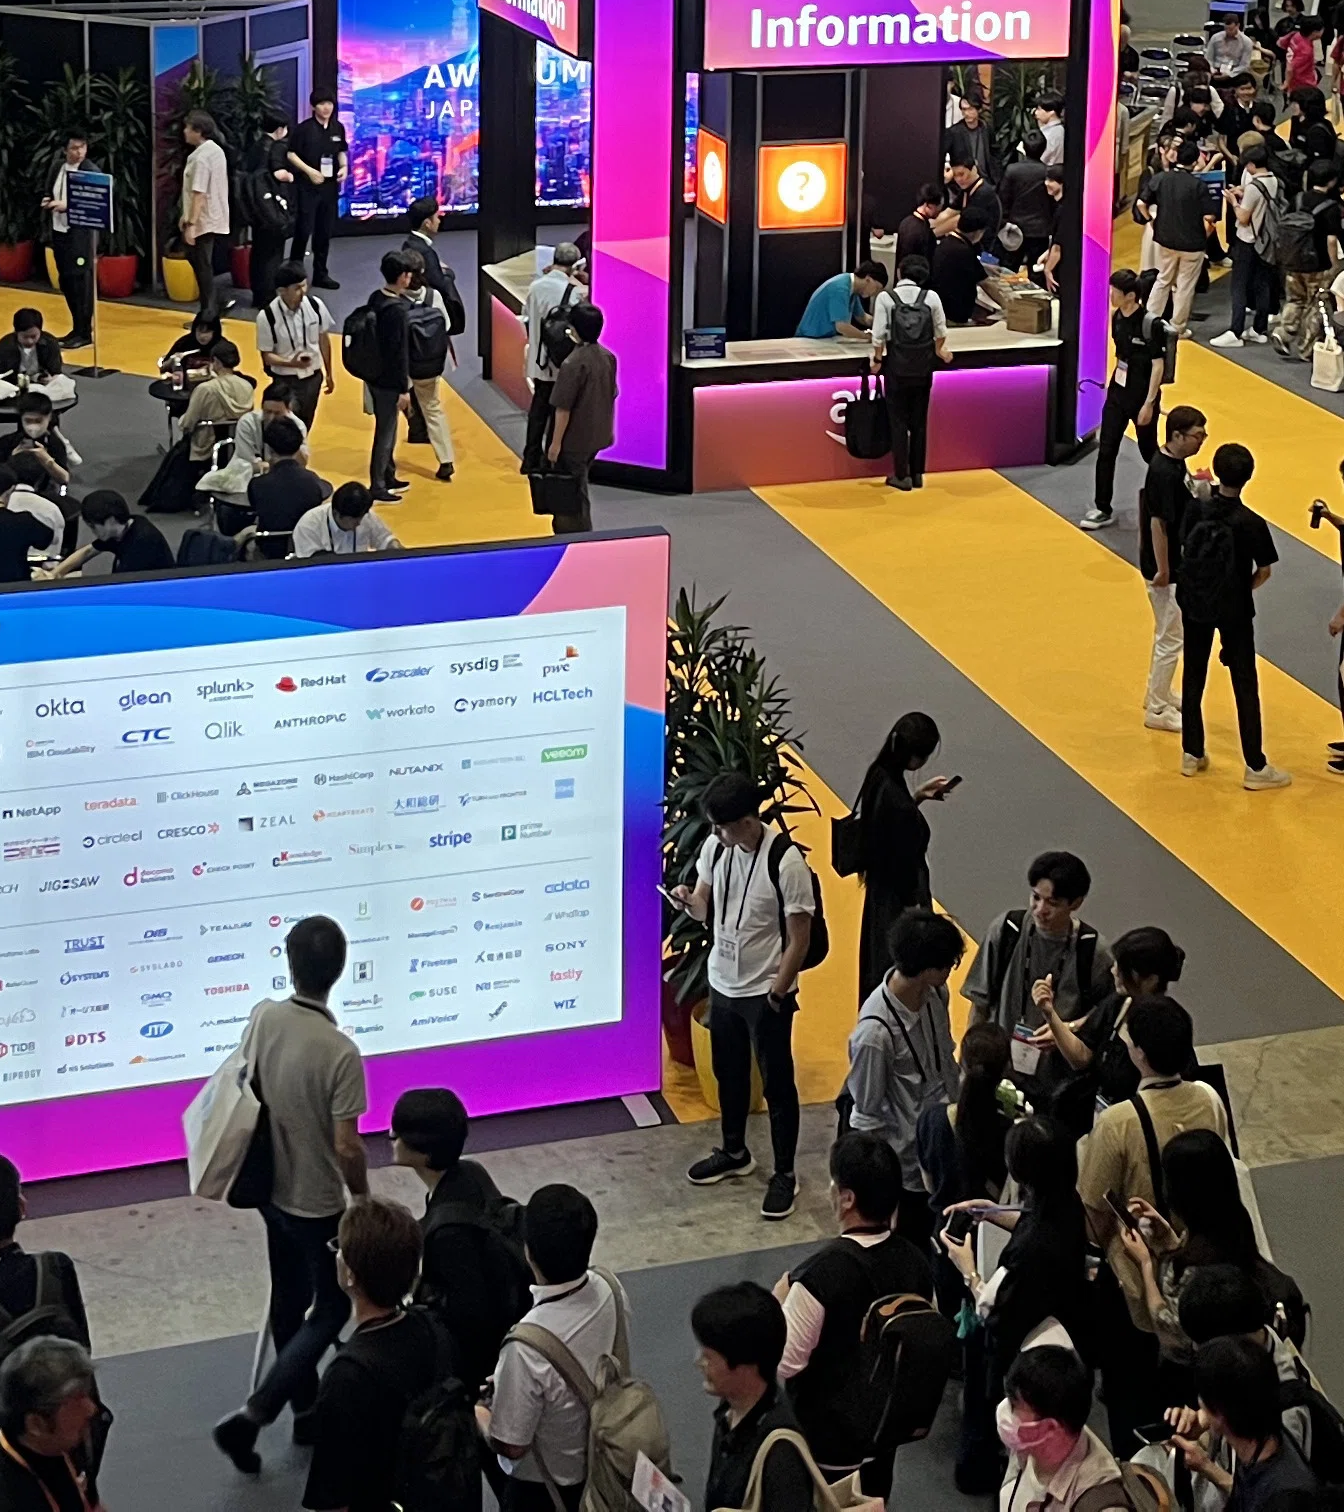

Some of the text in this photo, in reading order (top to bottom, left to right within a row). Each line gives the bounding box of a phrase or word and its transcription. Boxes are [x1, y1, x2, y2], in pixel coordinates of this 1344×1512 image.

[750, 0, 1033, 51] Information
[423, 63, 477, 89] AW
[388, 664, 436, 681] zscaler
[449, 655, 499, 675] sysdig
[542, 661, 571, 678] pwc
[300, 673, 347, 689] Red Hat
[118, 689, 172, 712] glean
[470, 694, 518, 711] yamory
[532, 686, 594, 705] HCLTech
[35, 696, 86, 719] okta
[386, 704, 436, 718] workato
[121, 726, 172, 745] CTC
[204, 720, 243, 741] Qlik
[543, 745, 586, 761] veeam
[328, 771, 375, 783] HashiCorp
[389, 762, 444, 777] NUTANIX
[170, 788, 220, 801] ClickHouse
[16, 804, 62, 819] NetApp
[84, 795, 138, 812] teradata
[259, 814, 297, 829] ZEAL
[157, 824, 206, 840] CRESCO
[429, 829, 473, 849] stripe
[348, 841, 394, 856] Simplex
[484, 919, 523, 931] Benjamin
[544, 939, 588, 953] SONY
[549, 967, 584, 983] fastly
[203, 982, 251, 997] TOSHIBA
[410, 1012, 460, 1028] AmiVoice
[77, 1031, 107, 1046] DTS
